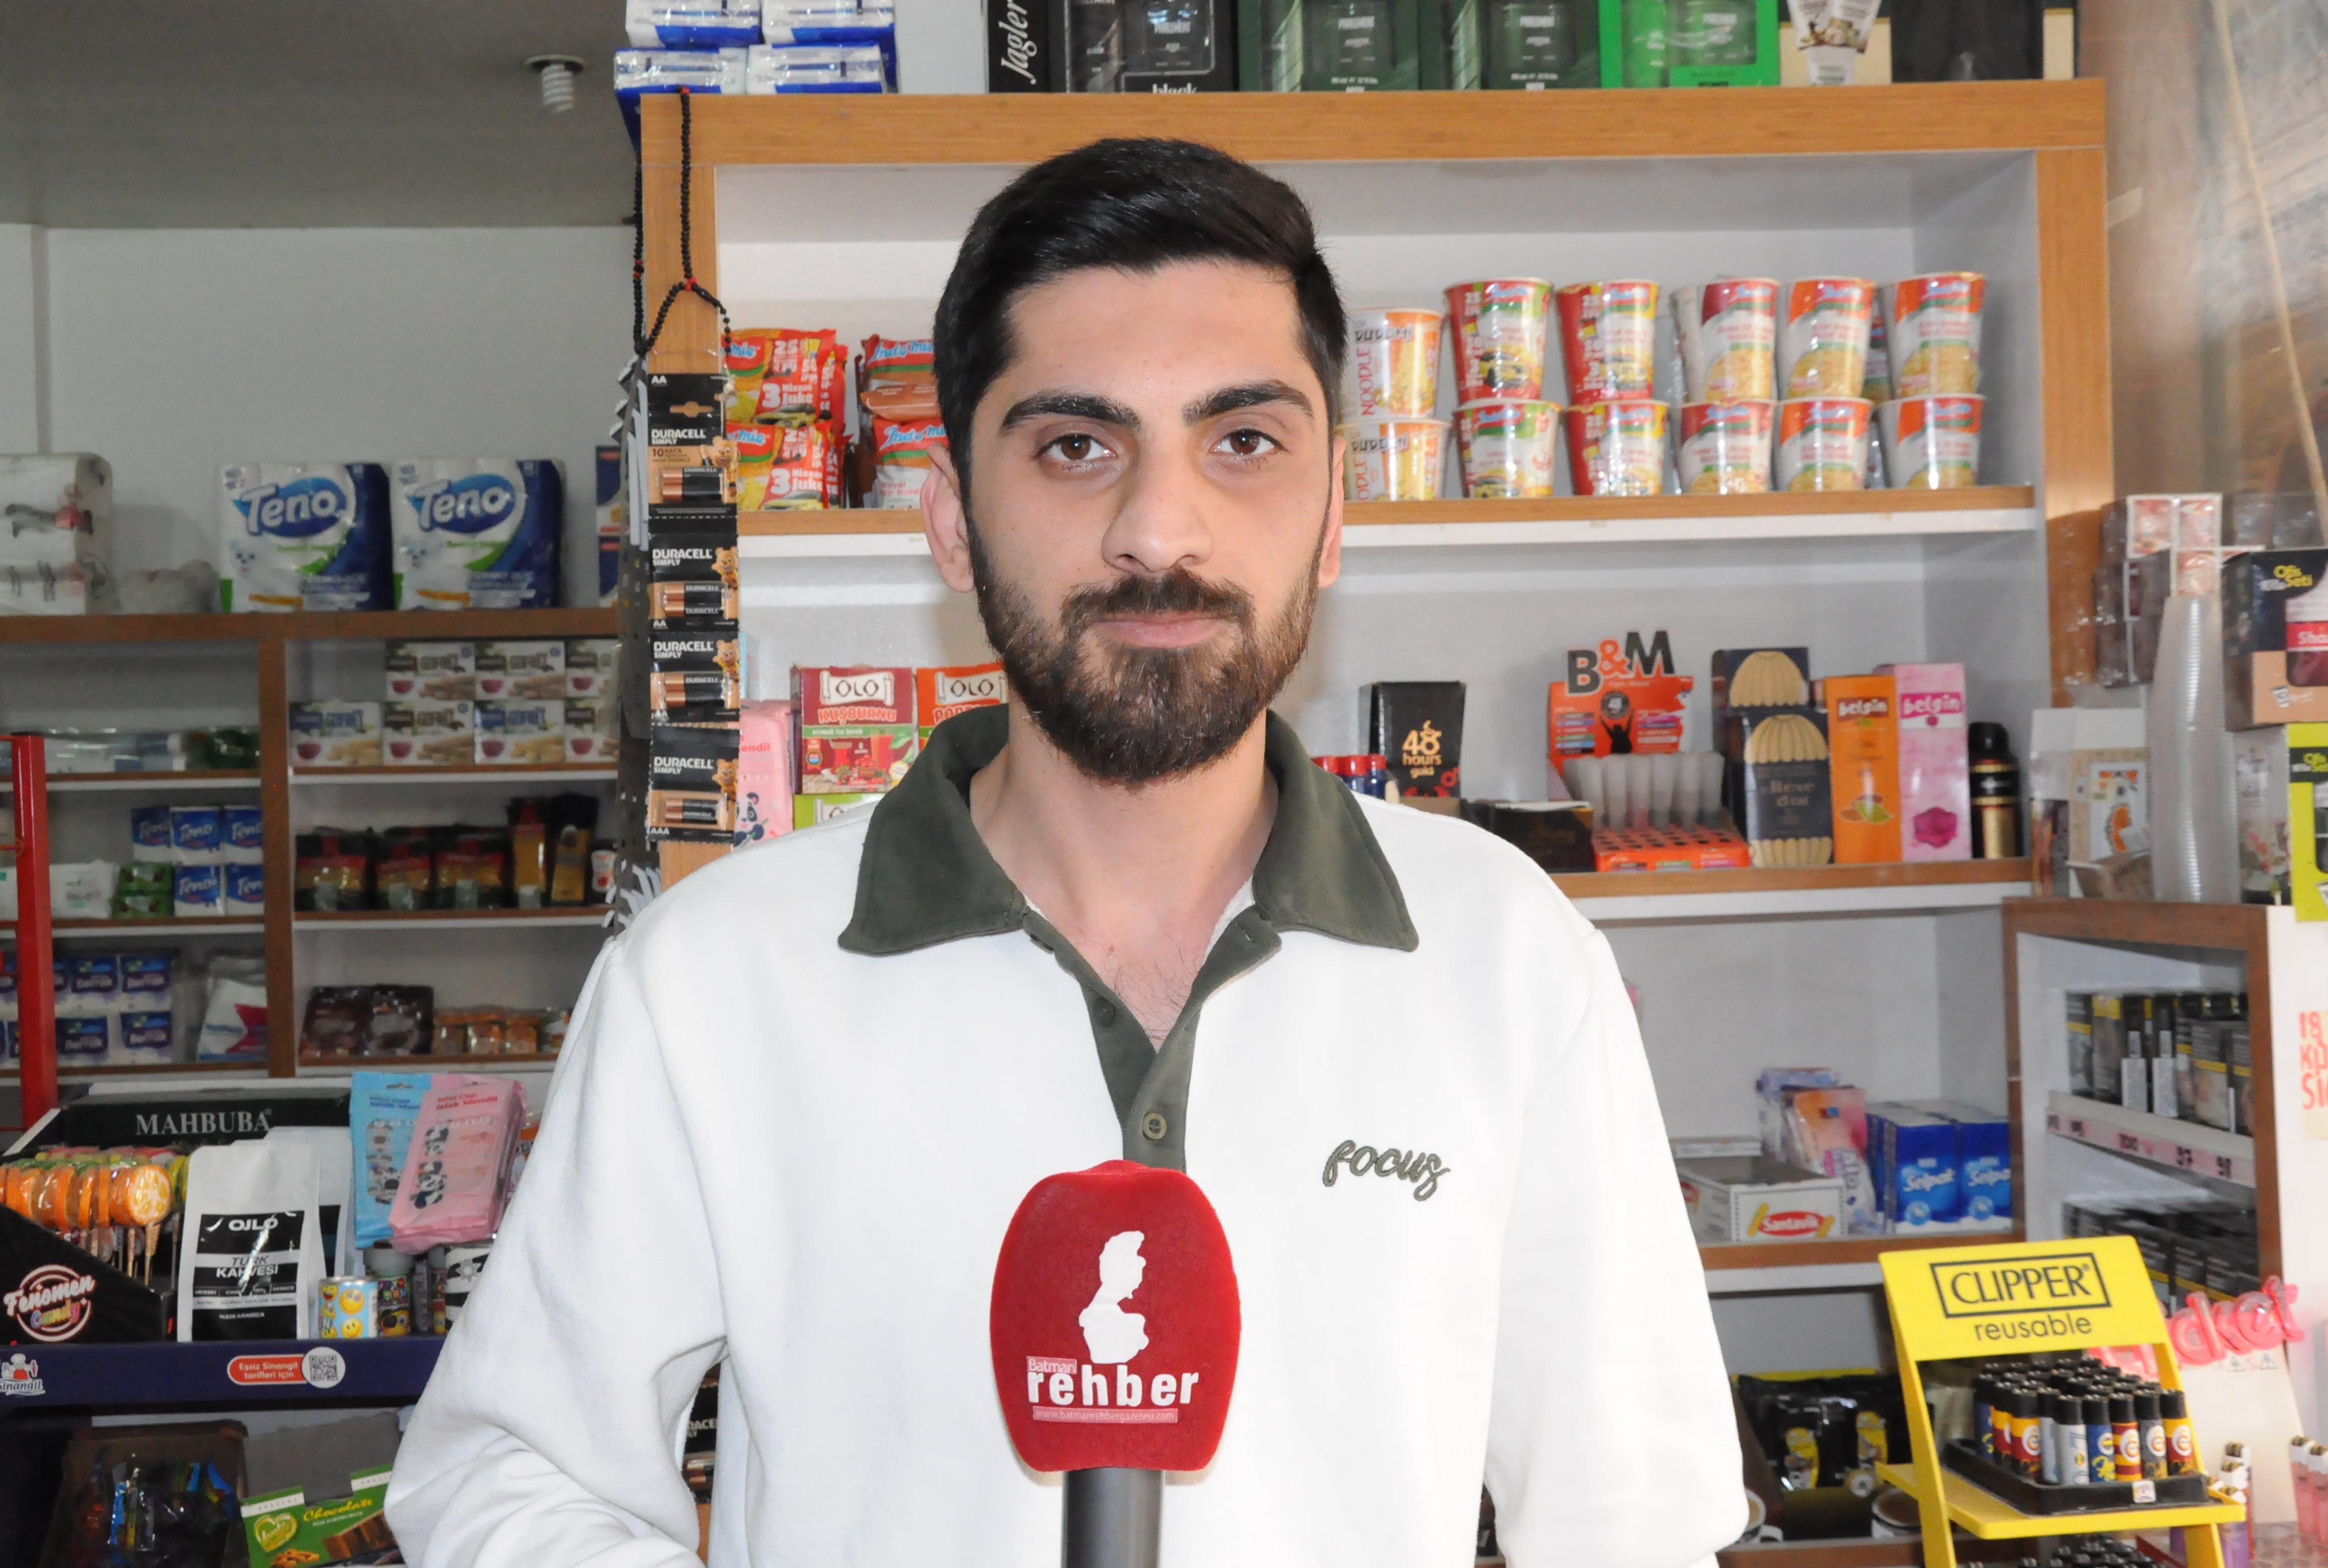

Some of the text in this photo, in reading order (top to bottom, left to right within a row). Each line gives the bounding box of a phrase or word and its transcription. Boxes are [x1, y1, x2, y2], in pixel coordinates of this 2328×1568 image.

[762, 382, 781, 408] 3
[651, 429, 706, 439] DURACELL
[879, 425, 947, 451] Indomi
[652, 448, 664, 457] 10
[770, 468, 790, 494] 3
[239, 483, 338, 537] Teno
[416, 479, 511, 532] Teno
[652, 549, 713, 559] DURACELL
[653, 641, 714, 652] DURACELL
[1566, 630, 1675, 695] B&M
[951, 679, 994, 697] OLO
[818, 707, 897, 725] KUŞBURNU
[741, 743, 770, 752] endil
[653, 756, 714, 770] DURACELL
[1402, 753, 1442, 765] hours
[1410, 766, 1434, 778] gold
[2299, 1011, 2322, 1039] 18
[136, 1112, 270, 1135] MAHBUBA
[1322, 1140, 1451, 1201] focus
[1951, 1265, 2092, 1304] CLIPPER
[3, 1276, 96, 1316] Fenomen
[1975, 1315, 2092, 1341] reusable
[262, 1362, 298, 1372] Sinangil
[1028, 1360, 1076, 1373] Batman
[1027, 1364, 1200, 1407] rehber
[689, 1418, 717, 1430] RACE
[1036, 1409, 1174, 1423] www.batmanrehbergazetesi.com
